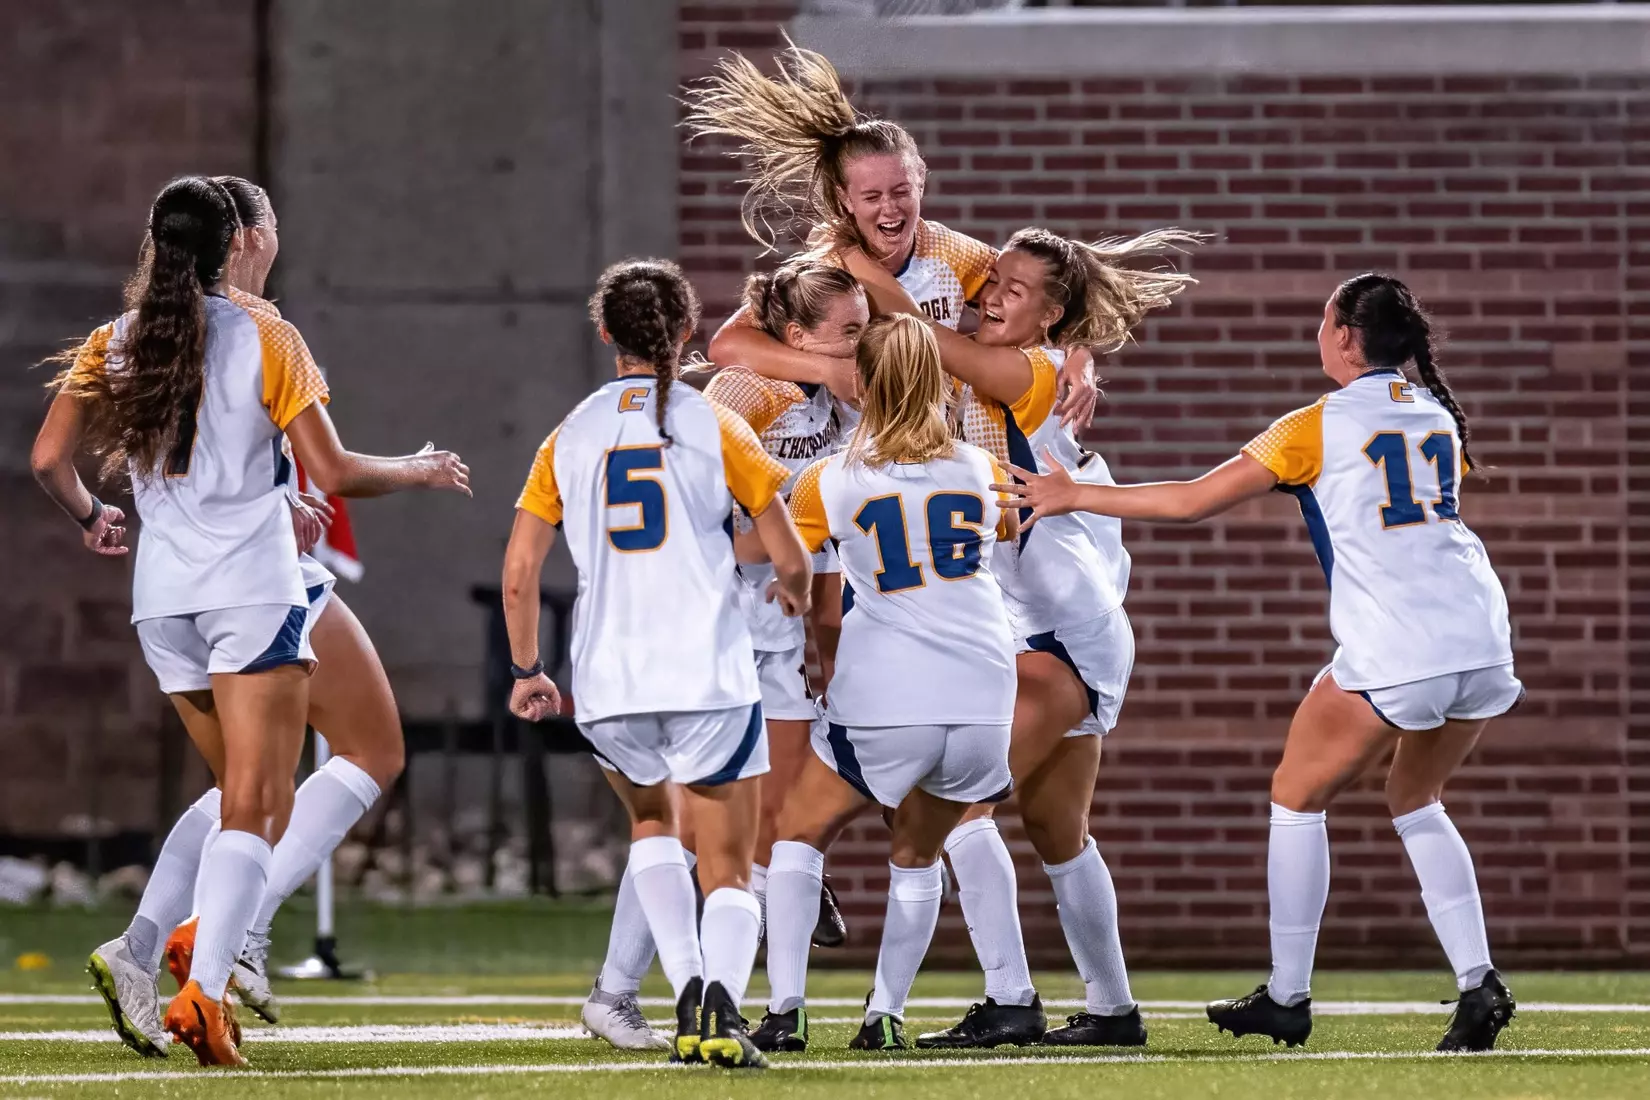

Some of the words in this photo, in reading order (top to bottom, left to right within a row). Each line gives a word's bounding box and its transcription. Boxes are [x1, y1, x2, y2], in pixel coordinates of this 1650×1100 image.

[617, 387, 650, 413] C
[604, 442, 669, 554] 5
[1360, 430, 1460, 531] 11
[852, 489, 986, 594] 16
